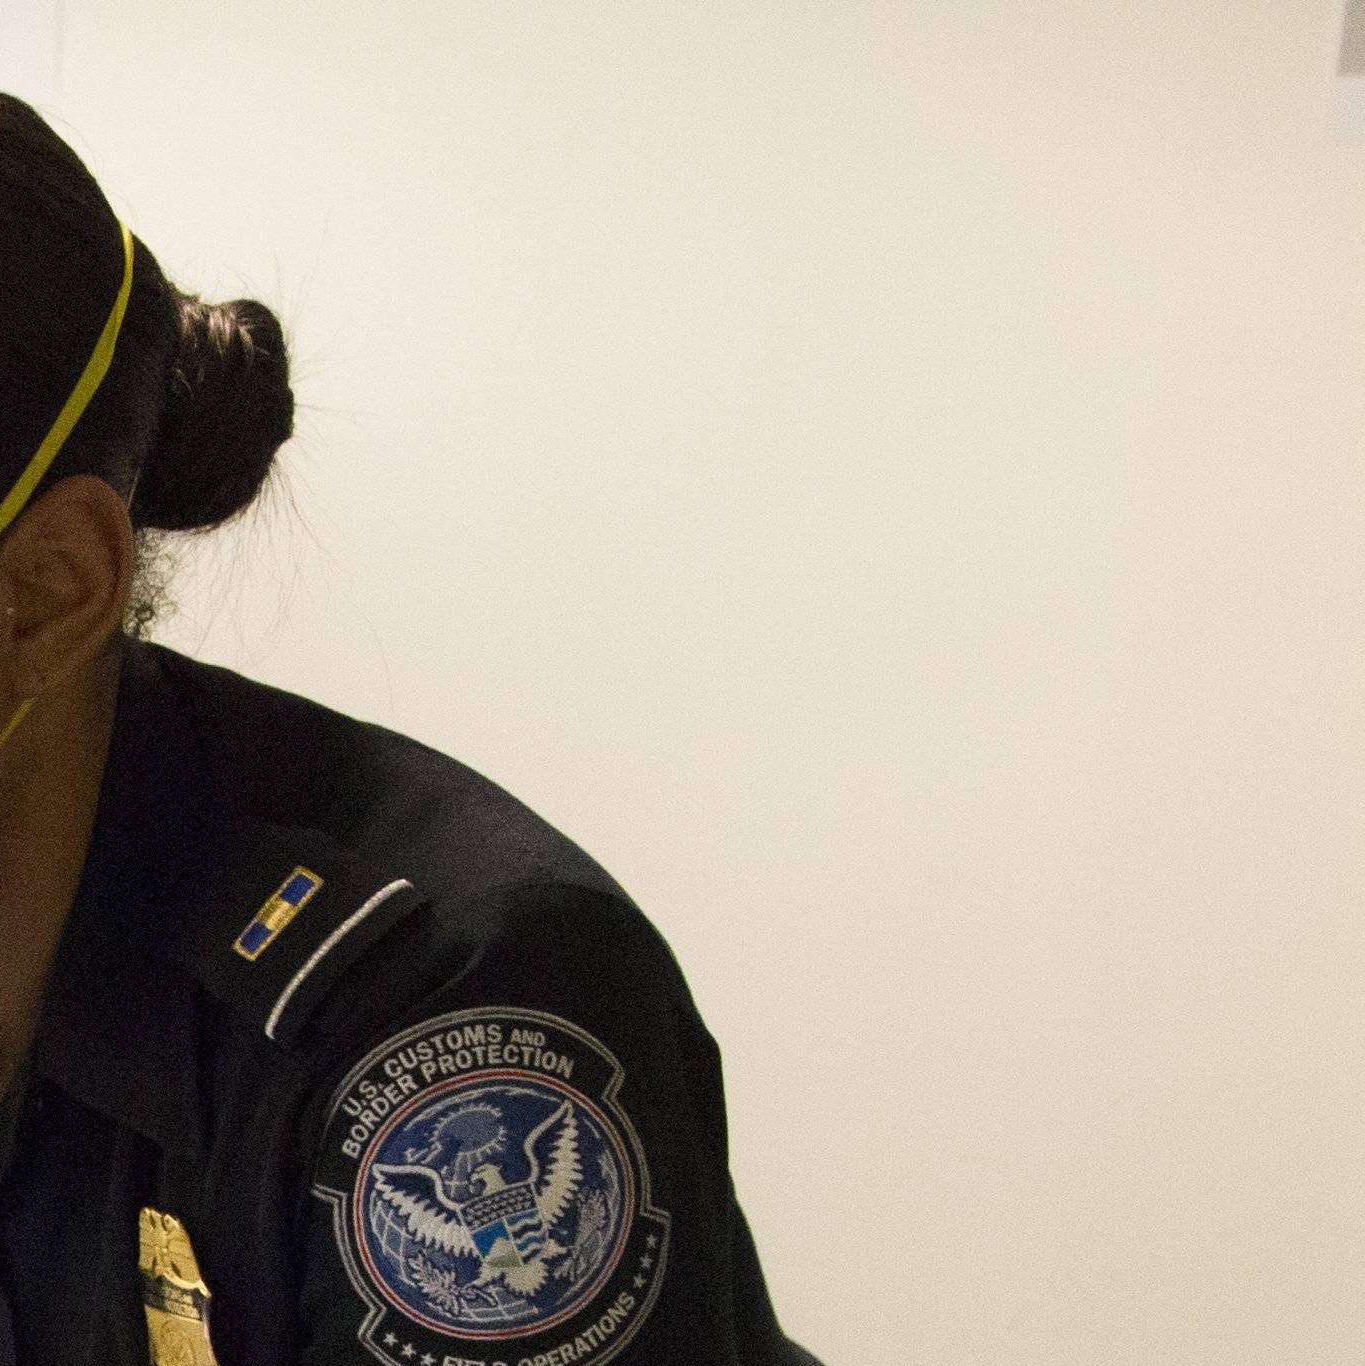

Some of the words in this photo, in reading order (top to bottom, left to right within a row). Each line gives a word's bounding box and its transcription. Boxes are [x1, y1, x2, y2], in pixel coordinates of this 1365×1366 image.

[342, 1080, 385, 1117] U.S.
[384, 1024, 503, 1078] CUSTOMS
[510, 1029, 546, 1047] AND
[342, 1074, 419, 1160] BORDER
[420, 1044, 574, 1083] PROTECTION
